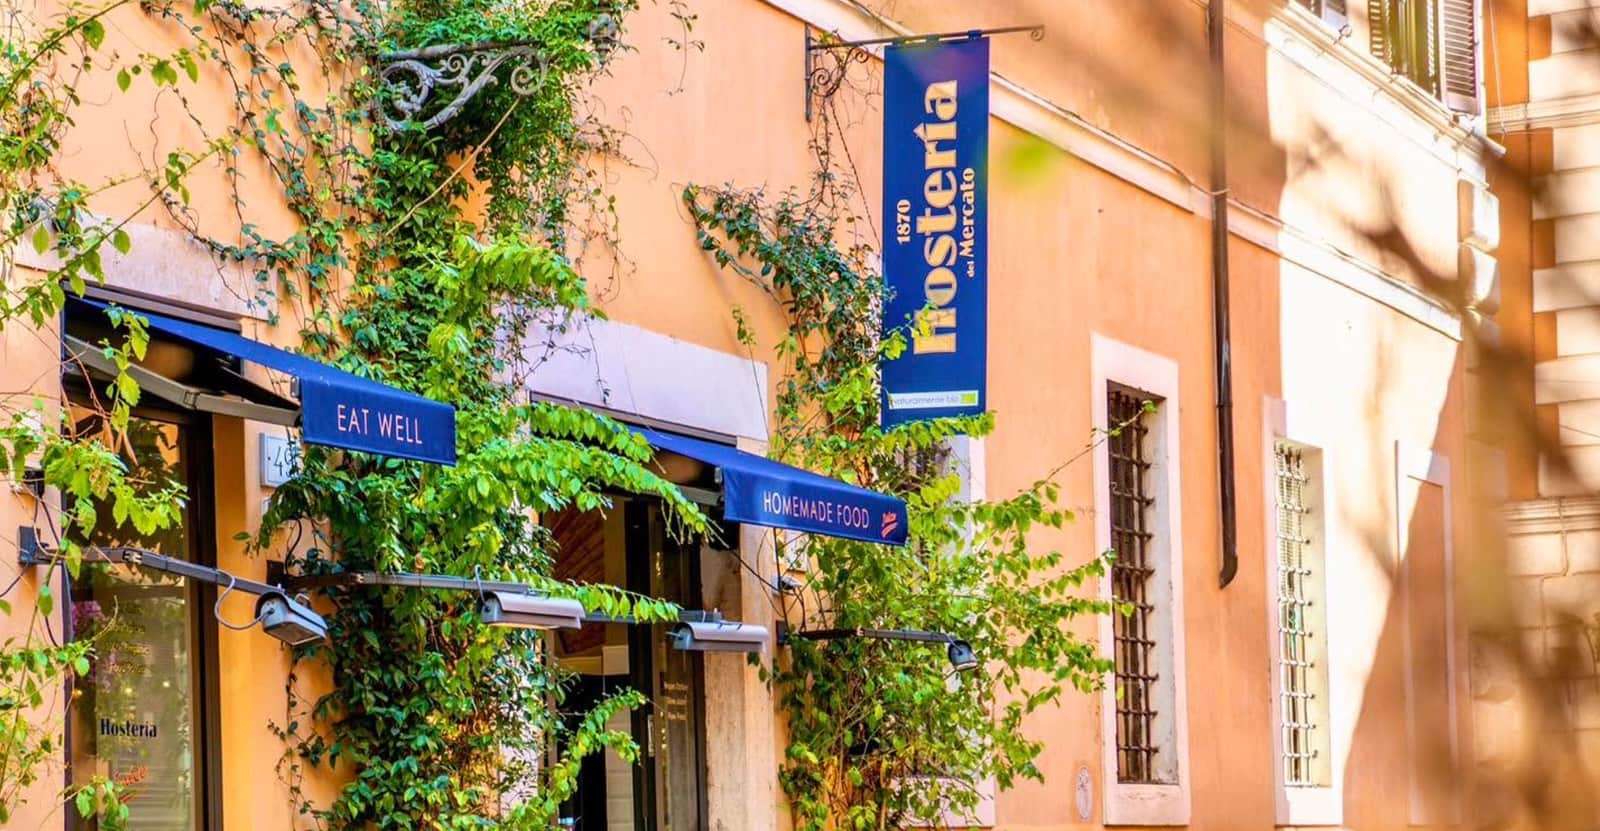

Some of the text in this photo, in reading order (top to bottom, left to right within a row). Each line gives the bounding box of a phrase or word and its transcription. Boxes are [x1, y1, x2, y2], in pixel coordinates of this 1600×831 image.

[897, 200, 911, 245] 1870
[960, 167, 975, 277] del Mercato
[338, 404, 423, 445] EAT WELL
[764, 491, 833, 523] HOMEMADE
[837, 504, 869, 529] FOOD
[100, 717, 158, 738] Hosteria
